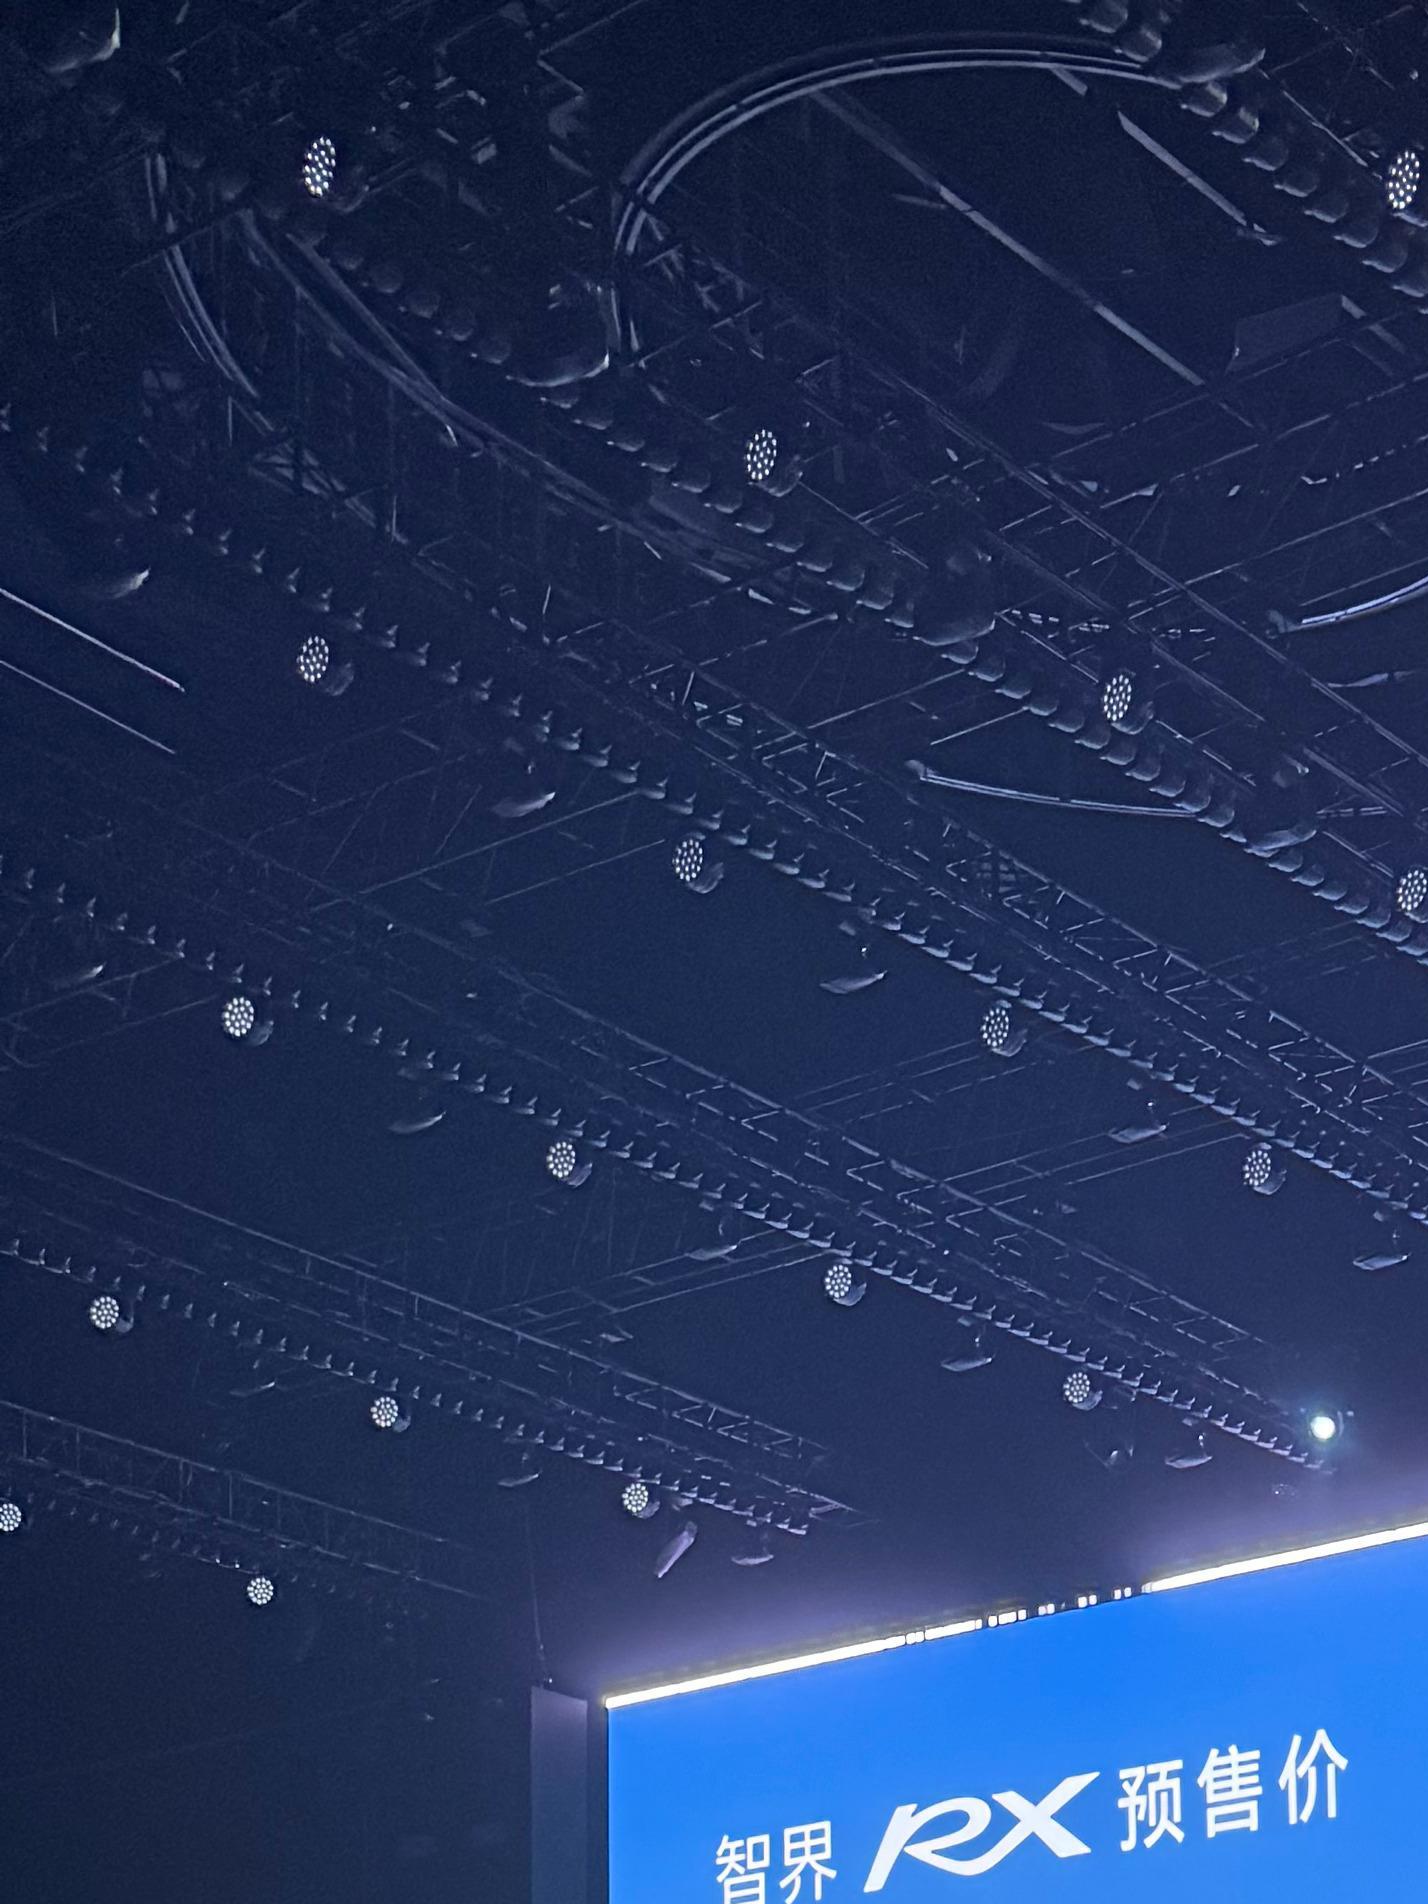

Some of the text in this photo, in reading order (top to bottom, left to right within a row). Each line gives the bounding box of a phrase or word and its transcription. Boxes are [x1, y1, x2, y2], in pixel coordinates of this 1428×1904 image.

[863, 1771, 1100, 1893] RX
[1117, 1728, 1349, 1852] 预售价
